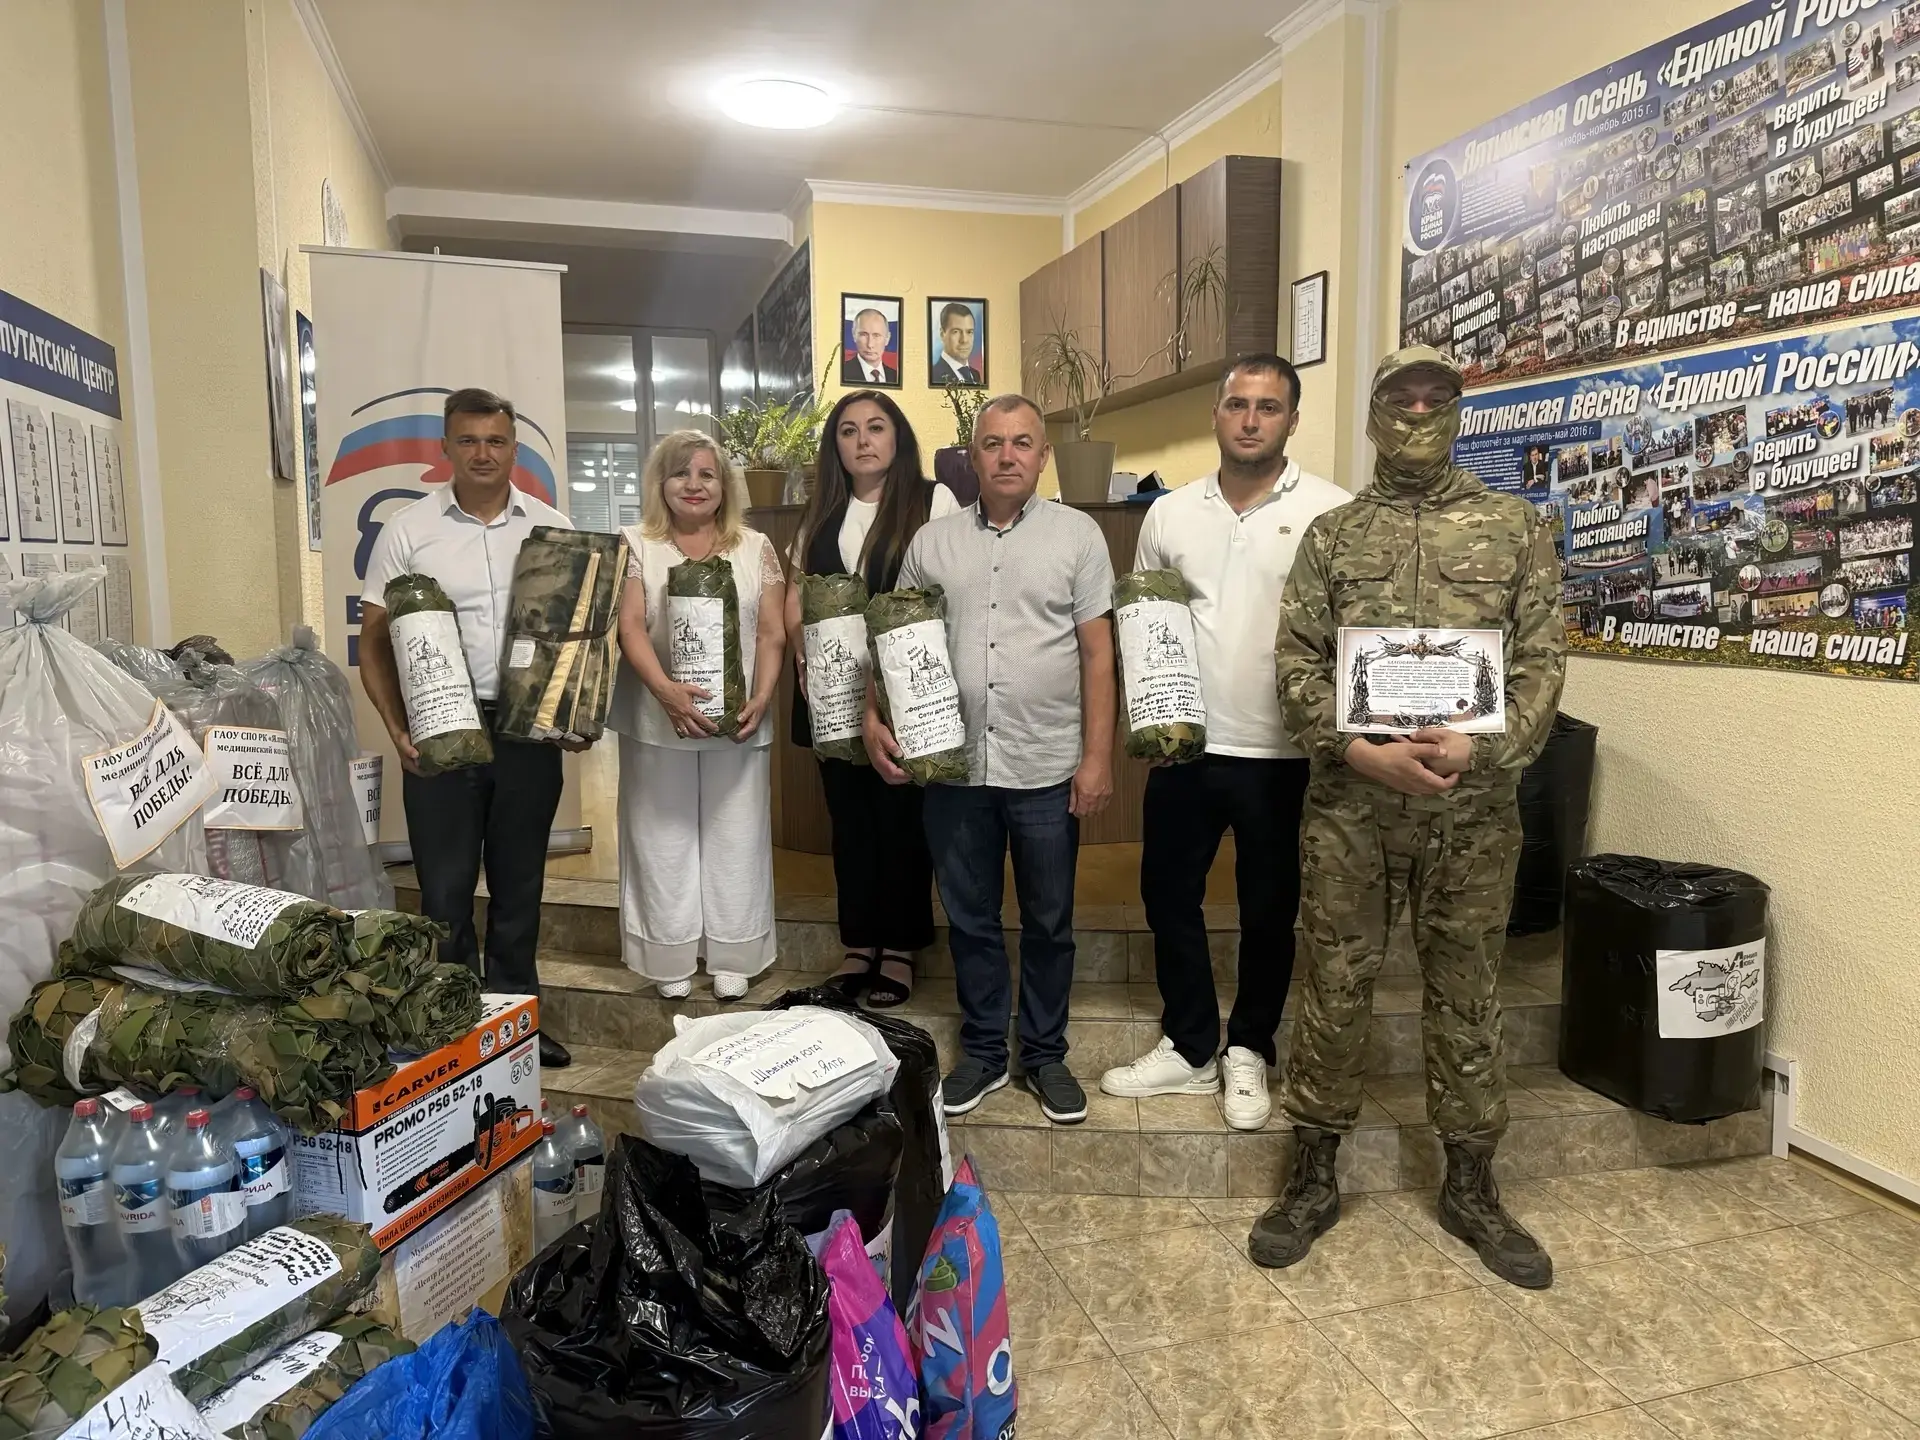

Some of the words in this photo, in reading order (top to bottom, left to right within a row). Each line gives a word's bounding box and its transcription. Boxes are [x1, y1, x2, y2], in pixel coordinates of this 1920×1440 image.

[1461, 102, 1568, 177] Ялтинская
[1572, 69, 1648, 127] осень
[1621, 104, 1645, 124] 2015
[1645, 103, 1653, 115] г.
[1773, 81, 1842, 131] Верить
[1775, 135, 1788, 158] в
[1792, 82, 1889, 149] будущее!
[1420, 209, 1443, 226] КРЫМ
[1420, 218, 1443, 234] ЕДИНАЯ
[1420, 226, 1443, 241] РОССИЯ
[1579, 200, 1631, 240] Любить
[1581, 202, 1662, 260] настоящее!
[1452, 288, 1495, 323] Помнить
[1453, 301, 1500, 341] прошлое!
[1615, 318, 1630, 349] В
[1634, 301, 1737, 347] единстве
[1768, 279, 1841, 319] наша
[81, 356, 115, 395] ЦЕНТР
[1458, 396, 1565, 437] Ялтинская
[1568, 384, 1640, 422] весна
[1456, 440, 1470, 452] Наш
[1470, 437, 1503, 451] фотоотчёт
[1503, 436, 1511, 446] за
[1512, 428, 1568, 445] март-апрель-май
[1570, 426, 1588, 437] 2016
[1588, 426, 1595, 435] г.
[1752, 431, 1817, 465] Верить
[1754, 470, 1766, 490] в
[1770, 445, 1859, 488] будущее!
[1571, 502, 1620, 531] Любить
[1572, 514, 1648, 550] настоящее!
[1602, 615, 1616, 642] В
[1620, 621, 1720, 650] единстве
[1749, 628, 1819, 658] наша
[1824, 632, 1909, 665] сила!
[918, 711, 934, 719] Сети
[94, 752, 123, 770] ГАОУ
[126, 741, 144, 758] СПО
[143, 732, 152, 747] РК
[214, 730, 239, 740] ГАОУ
[241, 731, 257, 741] СПО
[258, 733, 268, 742] РК
[216, 744, 273, 754] медицинский
[129, 769, 152, 801] ВСЁ
[155, 745, 185, 782] ДЛЯ
[232, 762, 263, 780] ВСЁ
[354, 763, 367, 771] ГАОУ
[133, 765, 193, 829] ПОБЕДЫ!
[1724, 1000, 1750, 1030] ШВЕЙНАЯ
[1739, 999, 1759, 1025] ГАСПРА
[383, 1058, 460, 1108] CARVER
[374, 1108, 426, 1150] PROMO
[428, 1094, 451, 1118] PSG
[453, 1074, 483, 1102] 52-18
[293, 1135, 316, 1148] PSG
[319, 1138, 352, 1153] 52-18
[379, 1228, 400, 1248] ПИЛА
[400, 1207, 428, 1231] ЦЕПНАЯ
[428, 1177, 471, 1212] БЕНЗИНОВАЯ
[409, 1242, 445, 1272] учреждение
[446, 1208, 493, 1245] дополнительного
[411, 1221, 459, 1258] Муниципальное
[414, 1271, 437, 1291] «Центр
[438, 1251, 465, 1275] развития
[466, 1228, 495, 1253] творчества
[470, 1267, 484, 1281] Ялта
[423, 1267, 472, 1307] муниципального
[473, 1252, 490, 1270] округа
[433, 1291, 468, 1319] Республики
[469, 1276, 485, 1294] Крым
